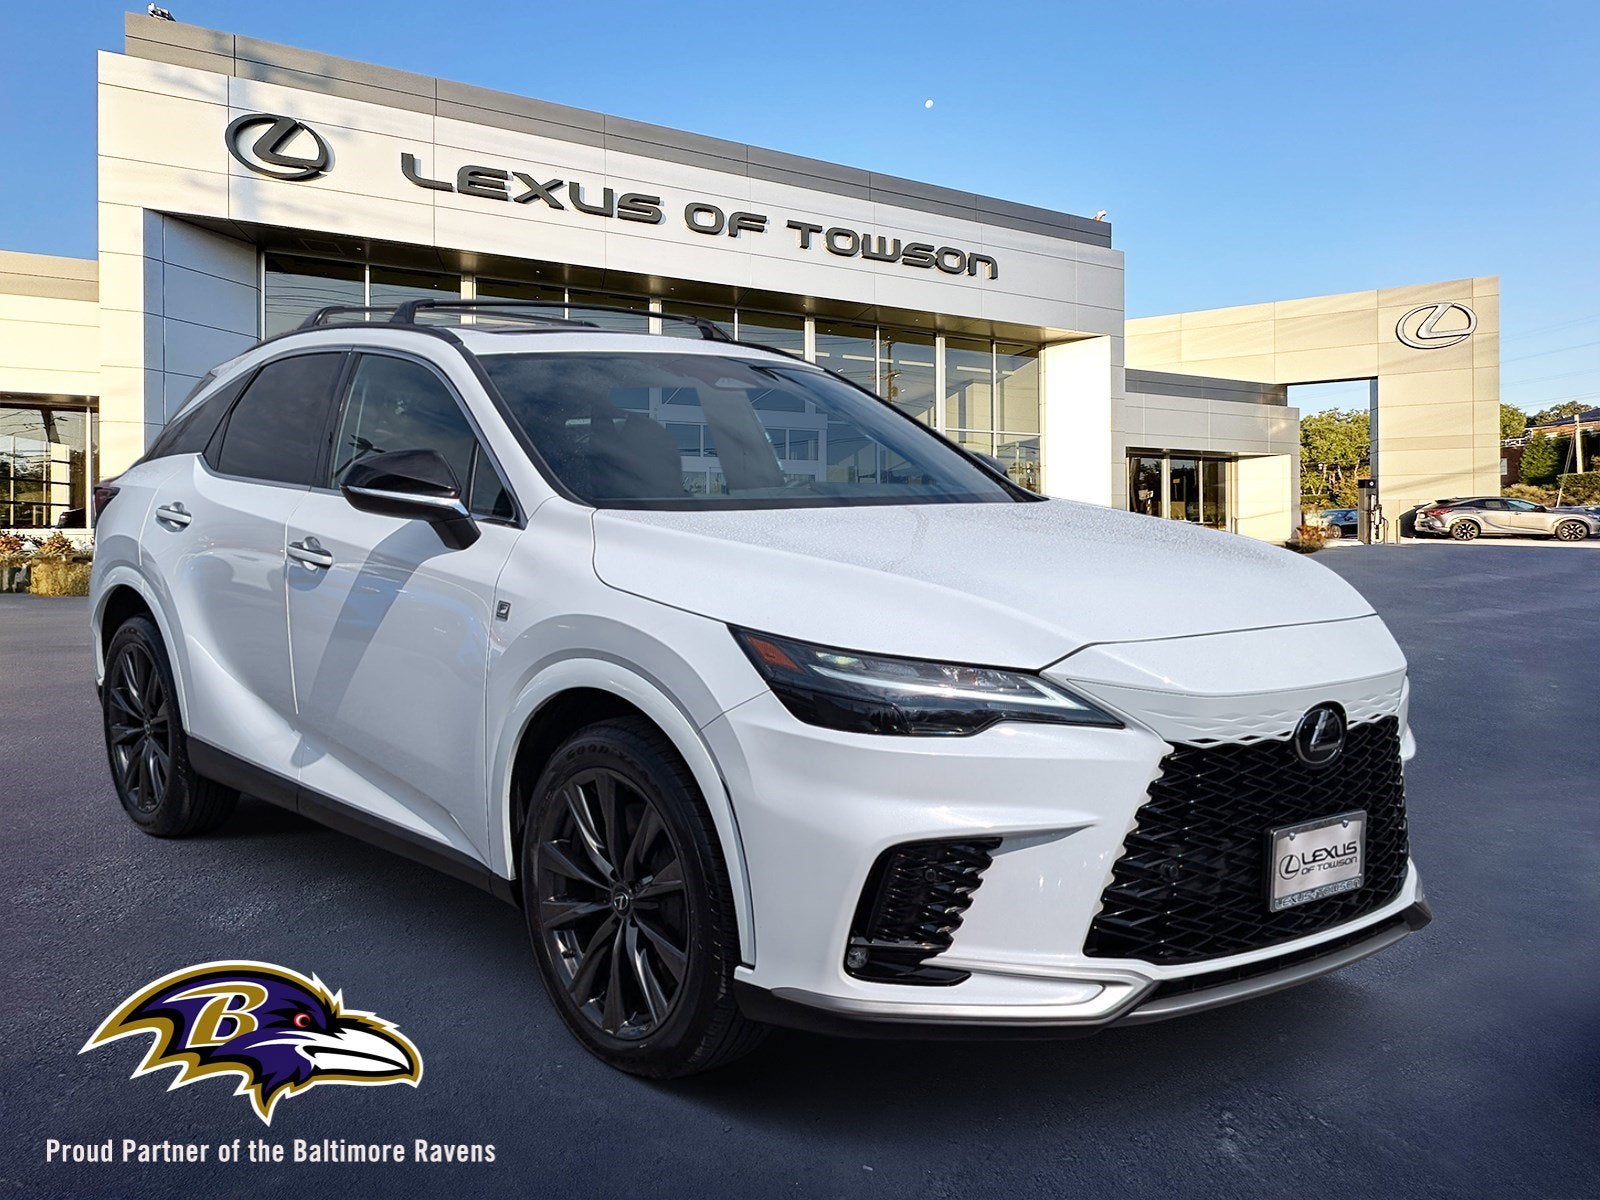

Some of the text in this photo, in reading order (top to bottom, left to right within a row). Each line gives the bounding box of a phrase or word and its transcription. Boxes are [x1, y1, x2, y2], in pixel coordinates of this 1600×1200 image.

[400, 152, 999, 280] LEXUS OF TOWSON
[1301, 840, 1358, 865] LEXUS
[1301, 856, 1358, 876] OF TOWSON
